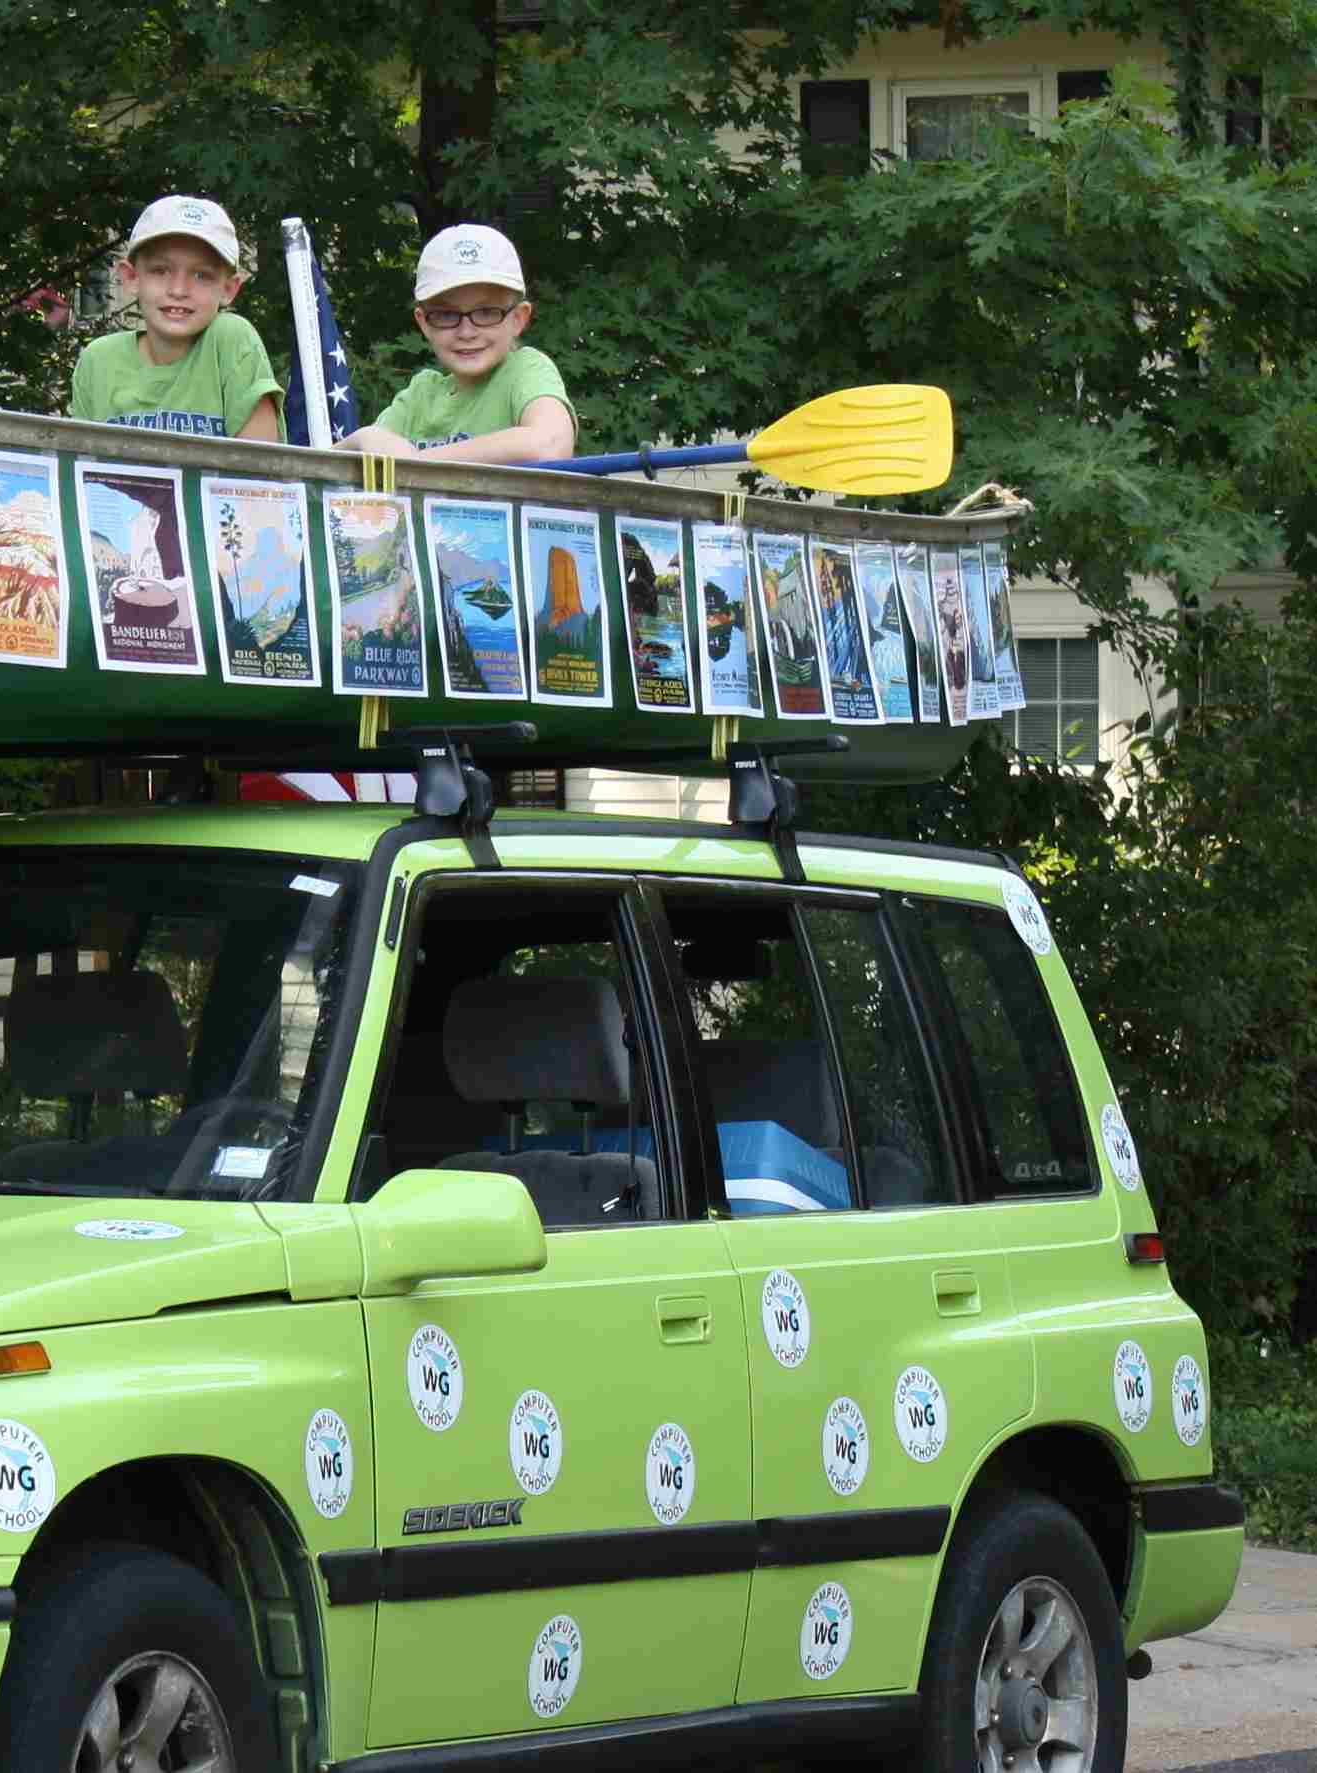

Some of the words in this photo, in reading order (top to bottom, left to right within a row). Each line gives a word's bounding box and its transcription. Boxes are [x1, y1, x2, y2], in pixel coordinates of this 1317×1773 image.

[110, 625, 168, 641] BANDELIER
[234, 649, 259, 659] BIG
[265, 651, 303, 661] BEND
[365, 647, 392, 663] BLUE
[396, 647, 420, 666] RIDGE
[354, 664, 409, 683] PARKWAY
[775, 1309, 800, 1333] WG
[413, 1330, 459, 1371] COMPUTER
[422, 1365, 450, 1397] WG
[897, 1370, 941, 1405] COMPUTER
[417, 1399, 453, 1427] SCHOOL
[515, 1395, 558, 1433] COMPUTER
[908, 1404, 935, 1429] WG
[524, 1432, 550, 1459] WG
[652, 1427, 692, 1465] COMPUTER
[835, 1433, 857, 1465] WG
[318, 1452, 343, 1480] WG
[518, 1465, 552, 1491] SCHOOL
[659, 1462, 683, 1490] WG
[402, 1497, 527, 1536] SIDEKICK
[814, 1621, 840, 1645] WG
[543, 1656, 570, 1682] WG
